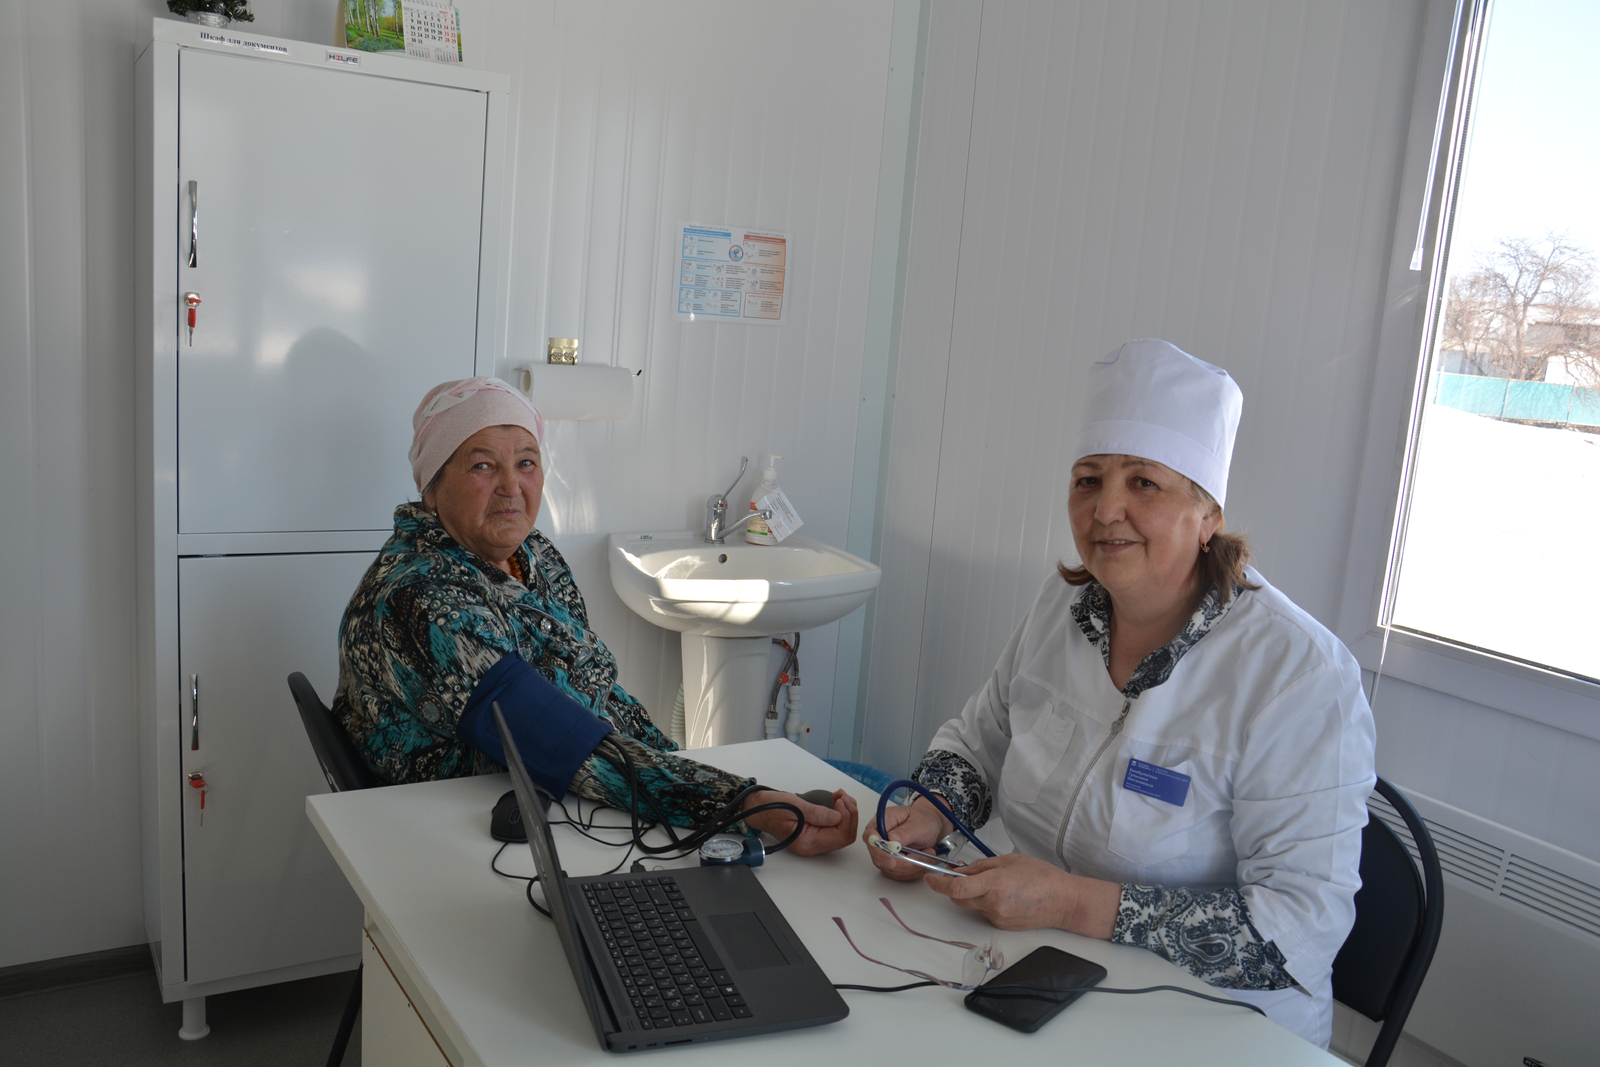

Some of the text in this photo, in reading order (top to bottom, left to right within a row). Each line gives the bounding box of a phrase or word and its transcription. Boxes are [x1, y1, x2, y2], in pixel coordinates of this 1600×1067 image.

[200, 32, 225, 43] Шкаф
[243, 40, 288, 52] документов
[329, 54, 358, 63] HILFE
